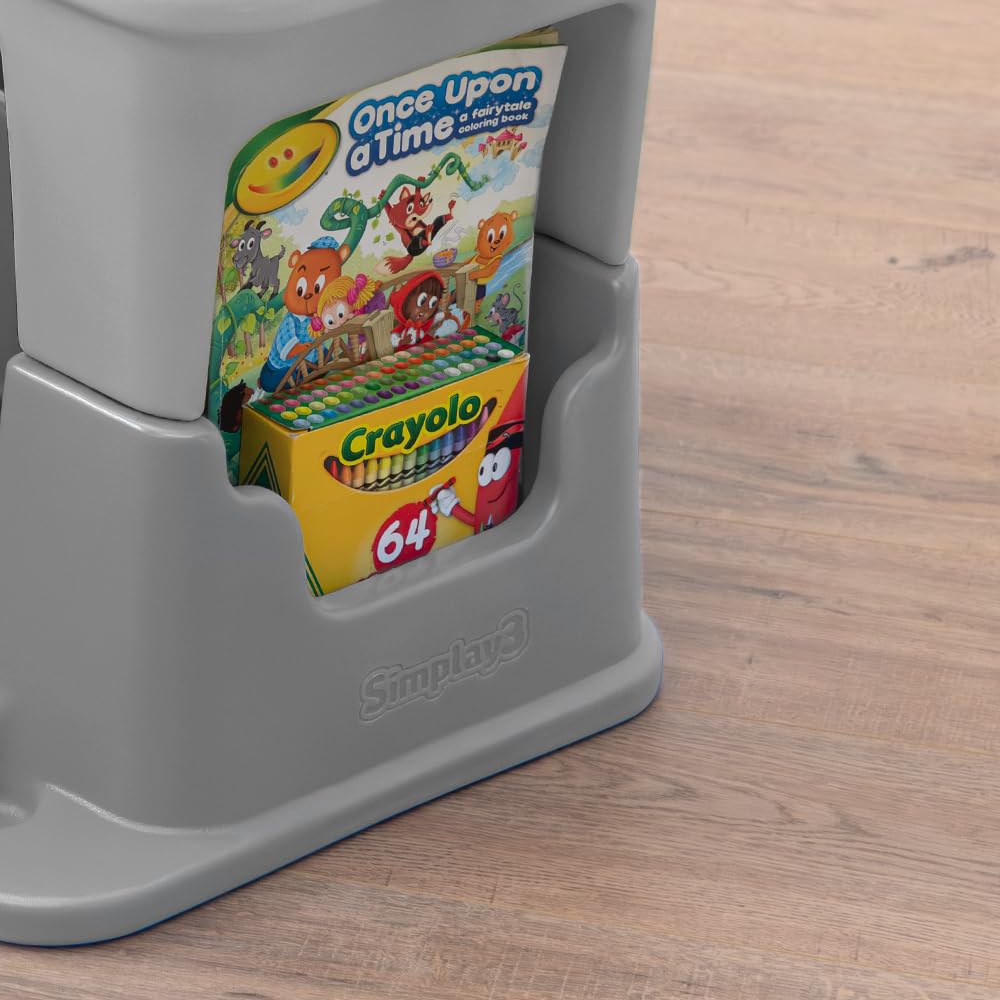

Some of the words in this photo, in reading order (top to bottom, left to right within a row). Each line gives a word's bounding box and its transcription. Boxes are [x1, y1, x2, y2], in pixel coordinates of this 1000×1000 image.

[354, 90, 435, 135] Once
[445, 71, 537, 107] Upon
[458, 117, 499, 134] coloring
[501, 113, 529, 124] book
[459, 112, 468, 122] a
[472, 100, 531, 120] fairytale
[376, 508, 431, 564] 64
[361, 609, 528, 722] Simplay3
